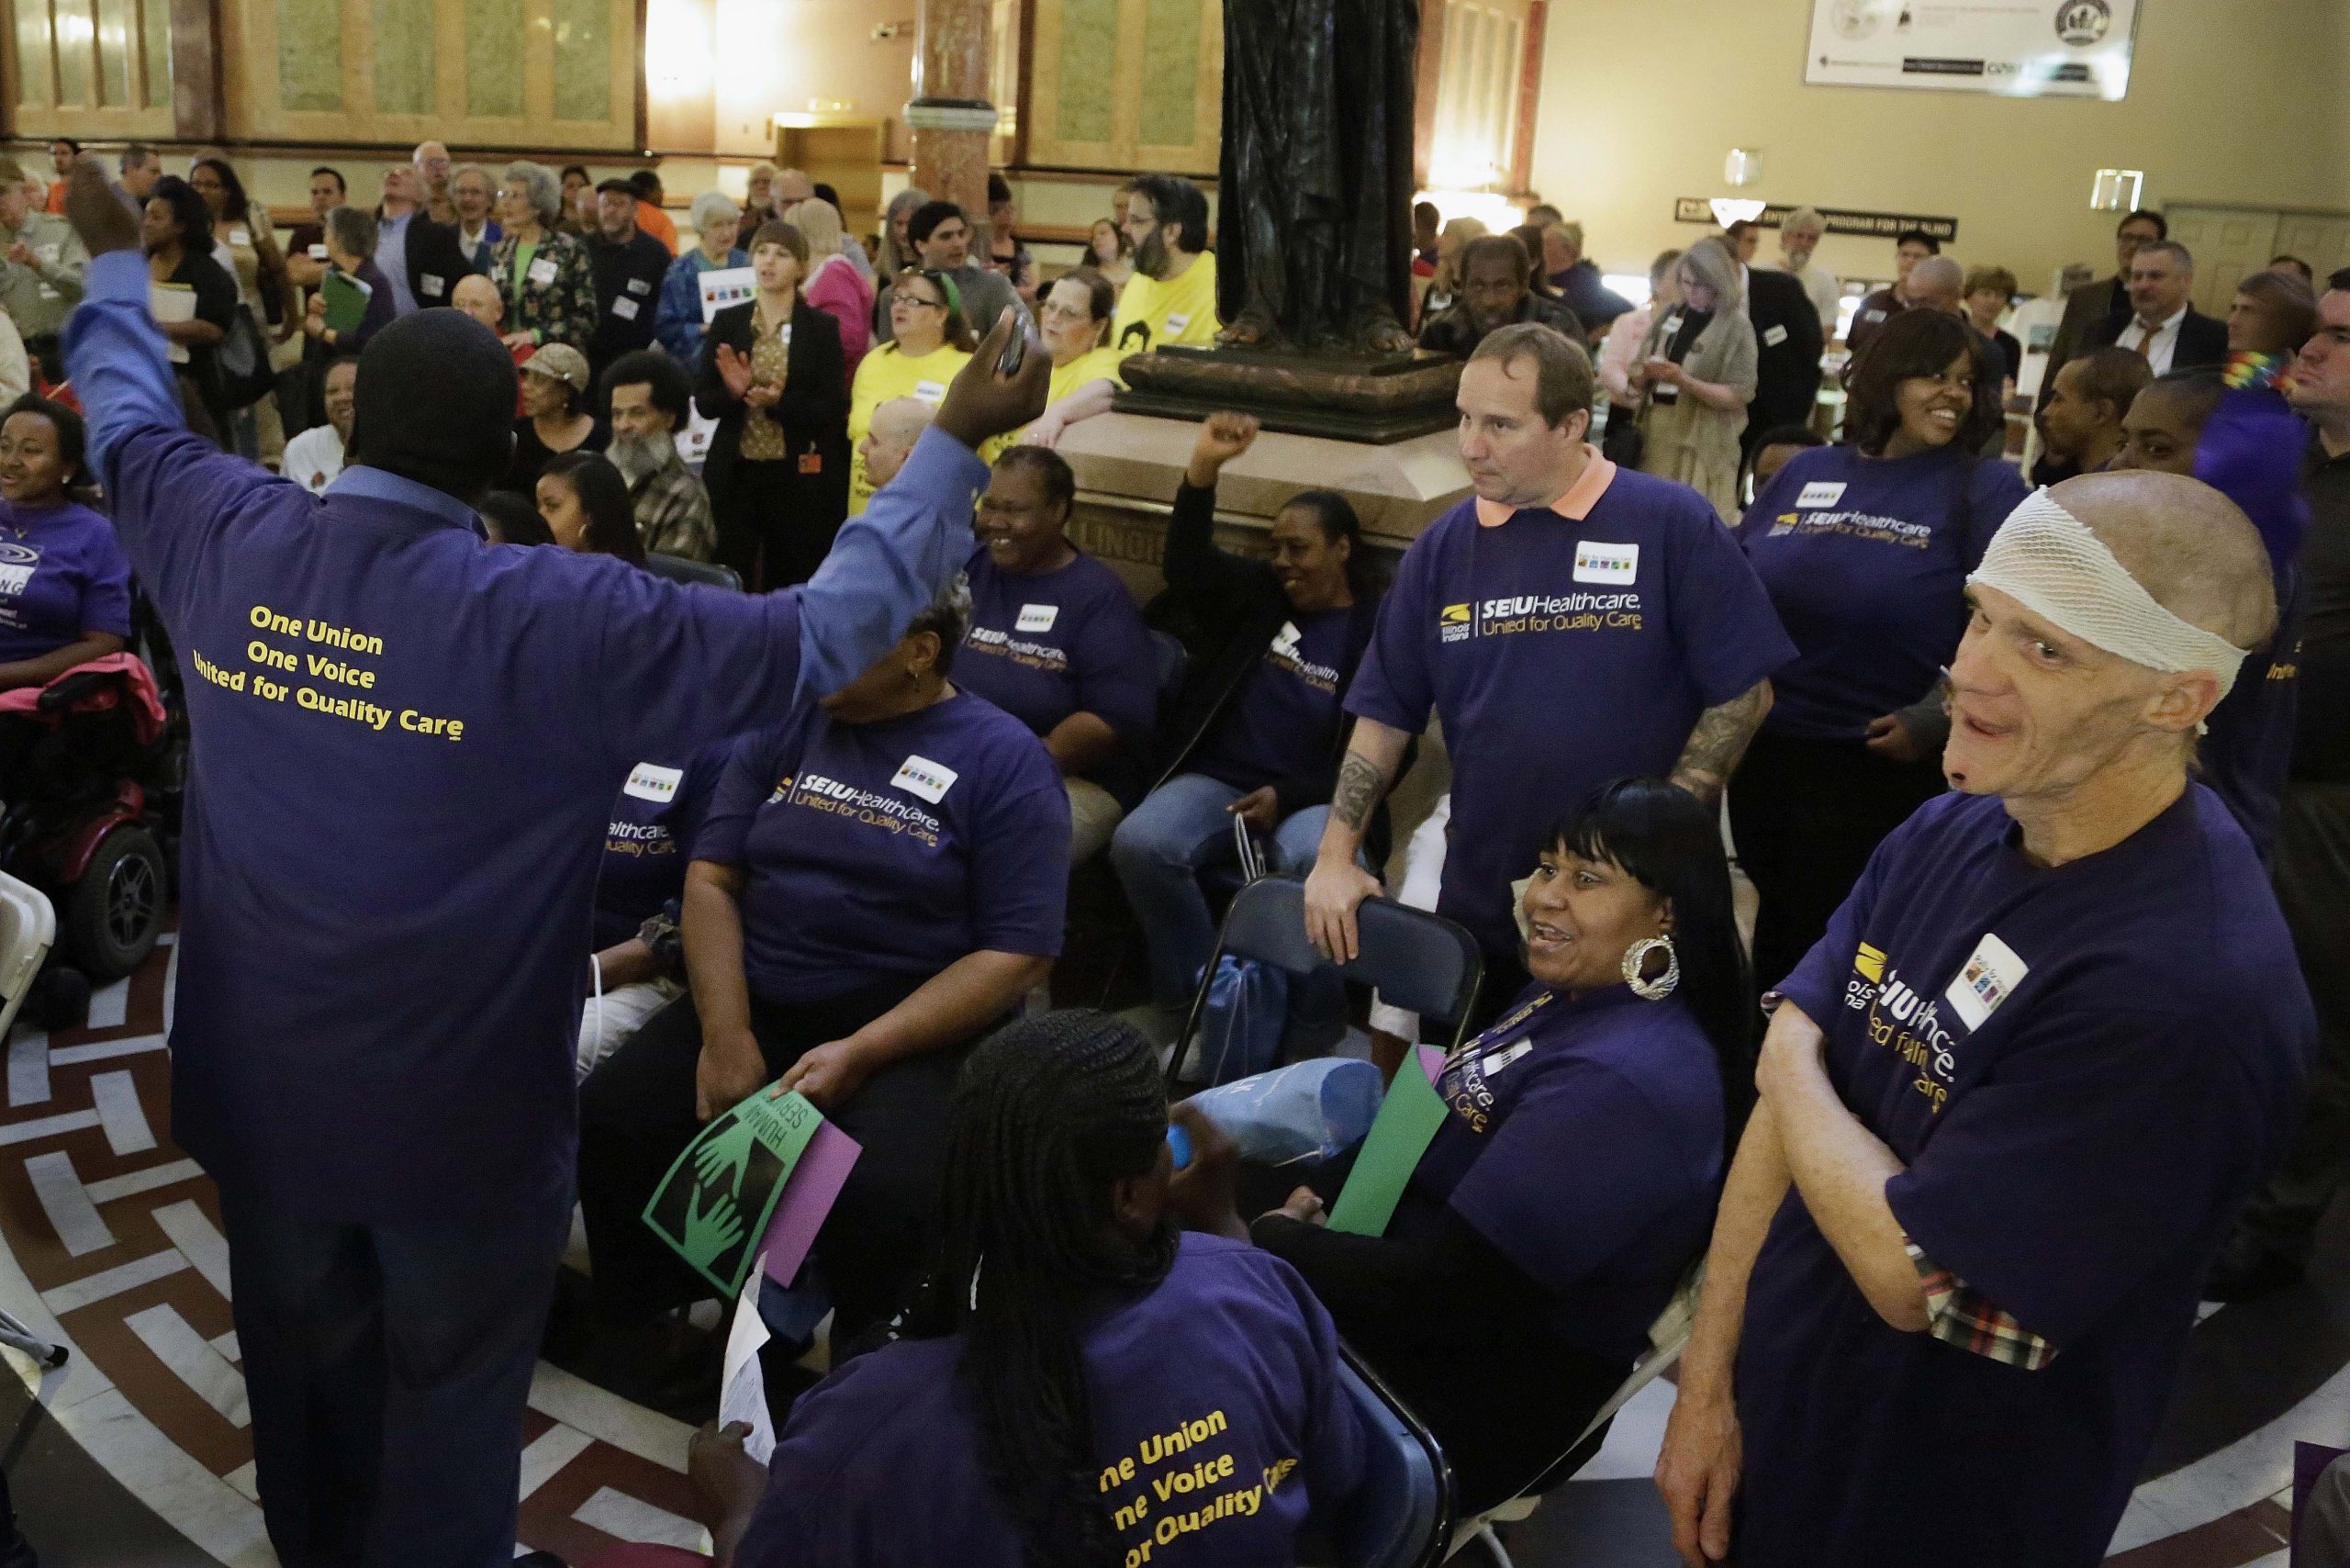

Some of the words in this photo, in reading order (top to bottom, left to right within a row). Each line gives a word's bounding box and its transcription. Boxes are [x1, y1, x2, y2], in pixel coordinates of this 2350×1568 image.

[250, 605, 303, 637] One
[307, 619, 384, 655] Union
[1483, 616, 1526, 636] United
[1528, 616, 1550, 632] for
[1553, 612, 1604, 632] Quality
[1606, 610, 1641, 629] Care
[193, 649, 246, 691] United
[252, 676, 289, 701] for
[296, 688, 392, 731] Quality
[399, 710, 464, 736] Care
[247, 640, 297, 672] One
[307, 654, 375, 689] Voice
[794, 791, 837, 812] United
[837, 801, 857, 817] for
[858, 809, 906, 834] Quality
[907, 823, 938, 846] Care
[1100, 1457, 1136, 1493] ne
[1139, 1410, 1228, 1465] Union
[1113, 1495, 1148, 1531] ne
[1151, 1453, 1235, 1503] Voice
[1125, 1539, 1153, 1568] or
[1155, 1484, 1262, 1546] Quality
